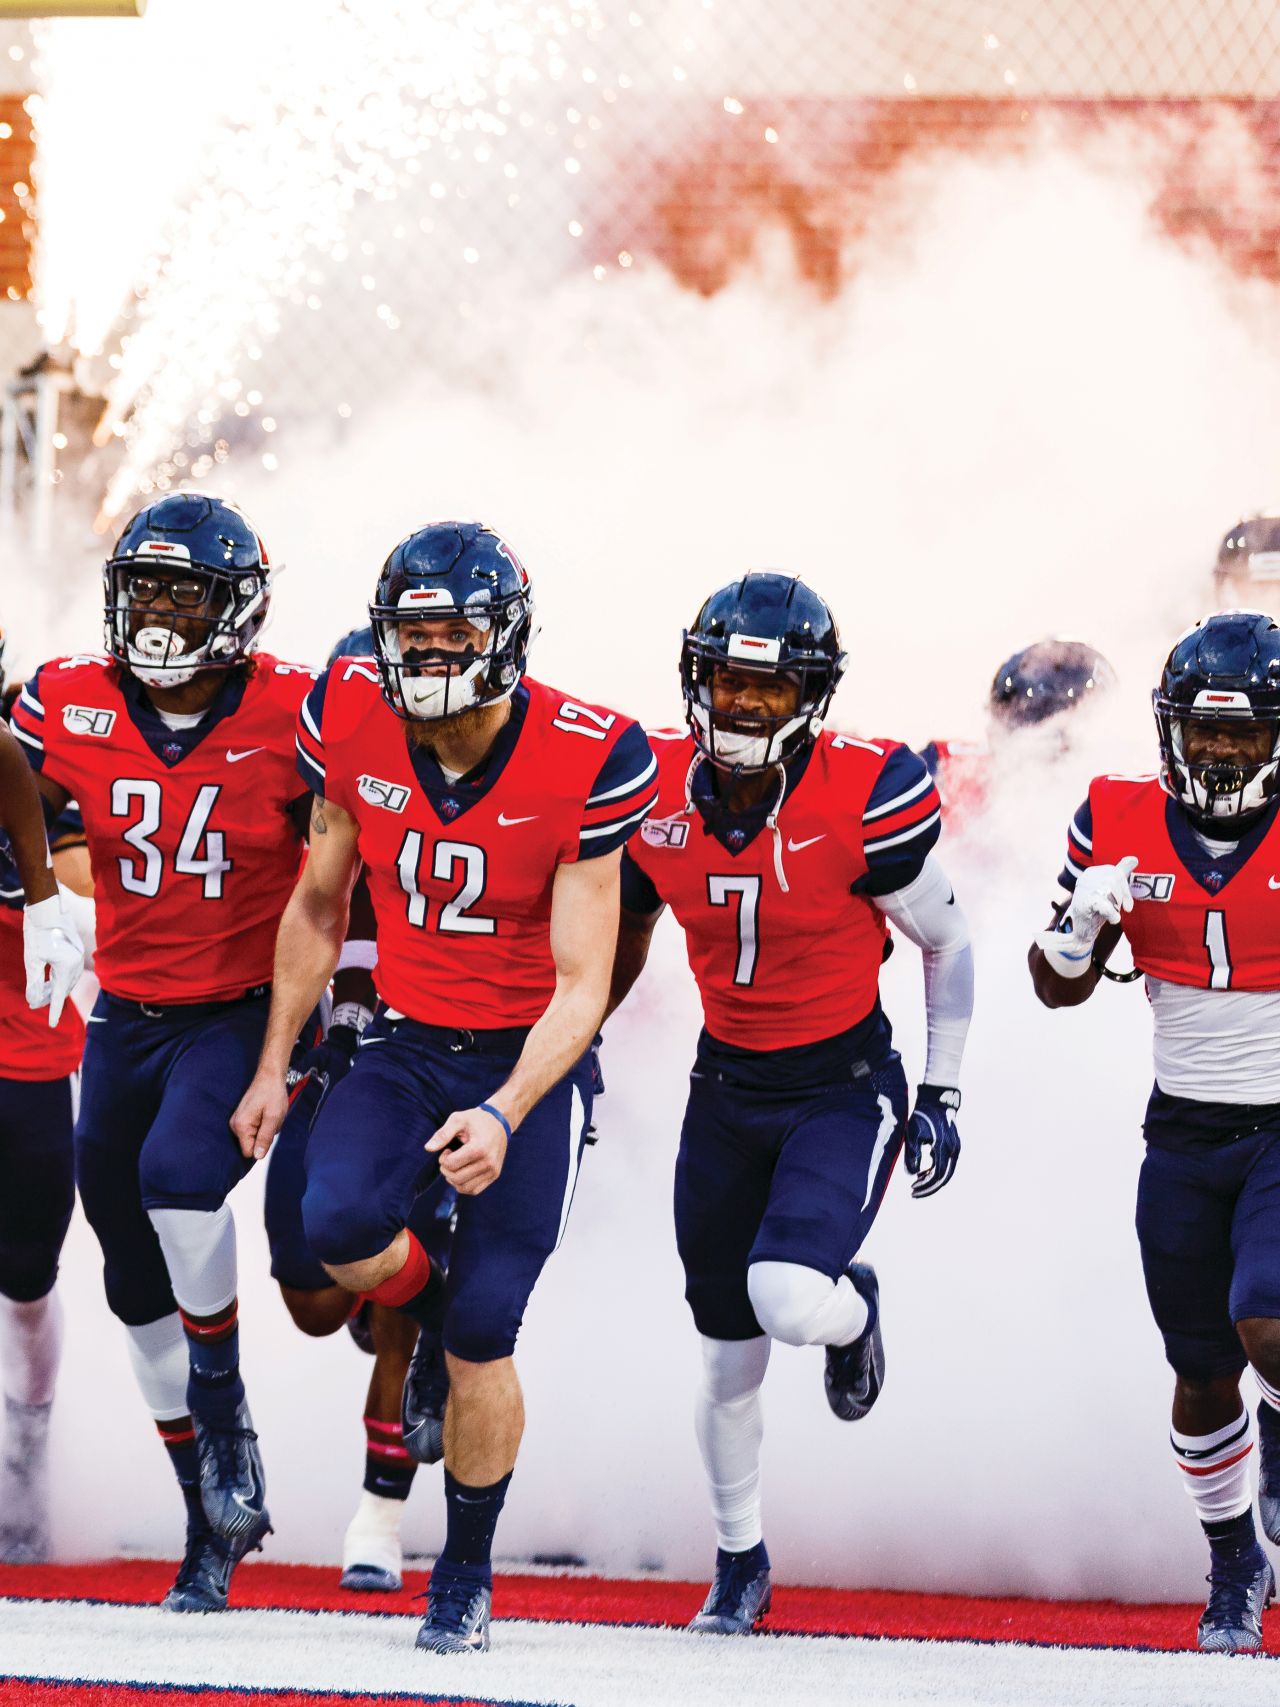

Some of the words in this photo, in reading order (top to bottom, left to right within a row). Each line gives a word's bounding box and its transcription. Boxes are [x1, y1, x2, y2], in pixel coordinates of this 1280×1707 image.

[63, 706, 114, 736] 150
[551, 701, 616, 741] 12
[358, 776, 409, 811] 150
[110, 778, 233, 900] 34
[395, 827, 497, 935] 12
[1129, 874, 1174, 900] 50
[706, 873, 762, 987] 7
[1204, 909, 1232, 990] 1
